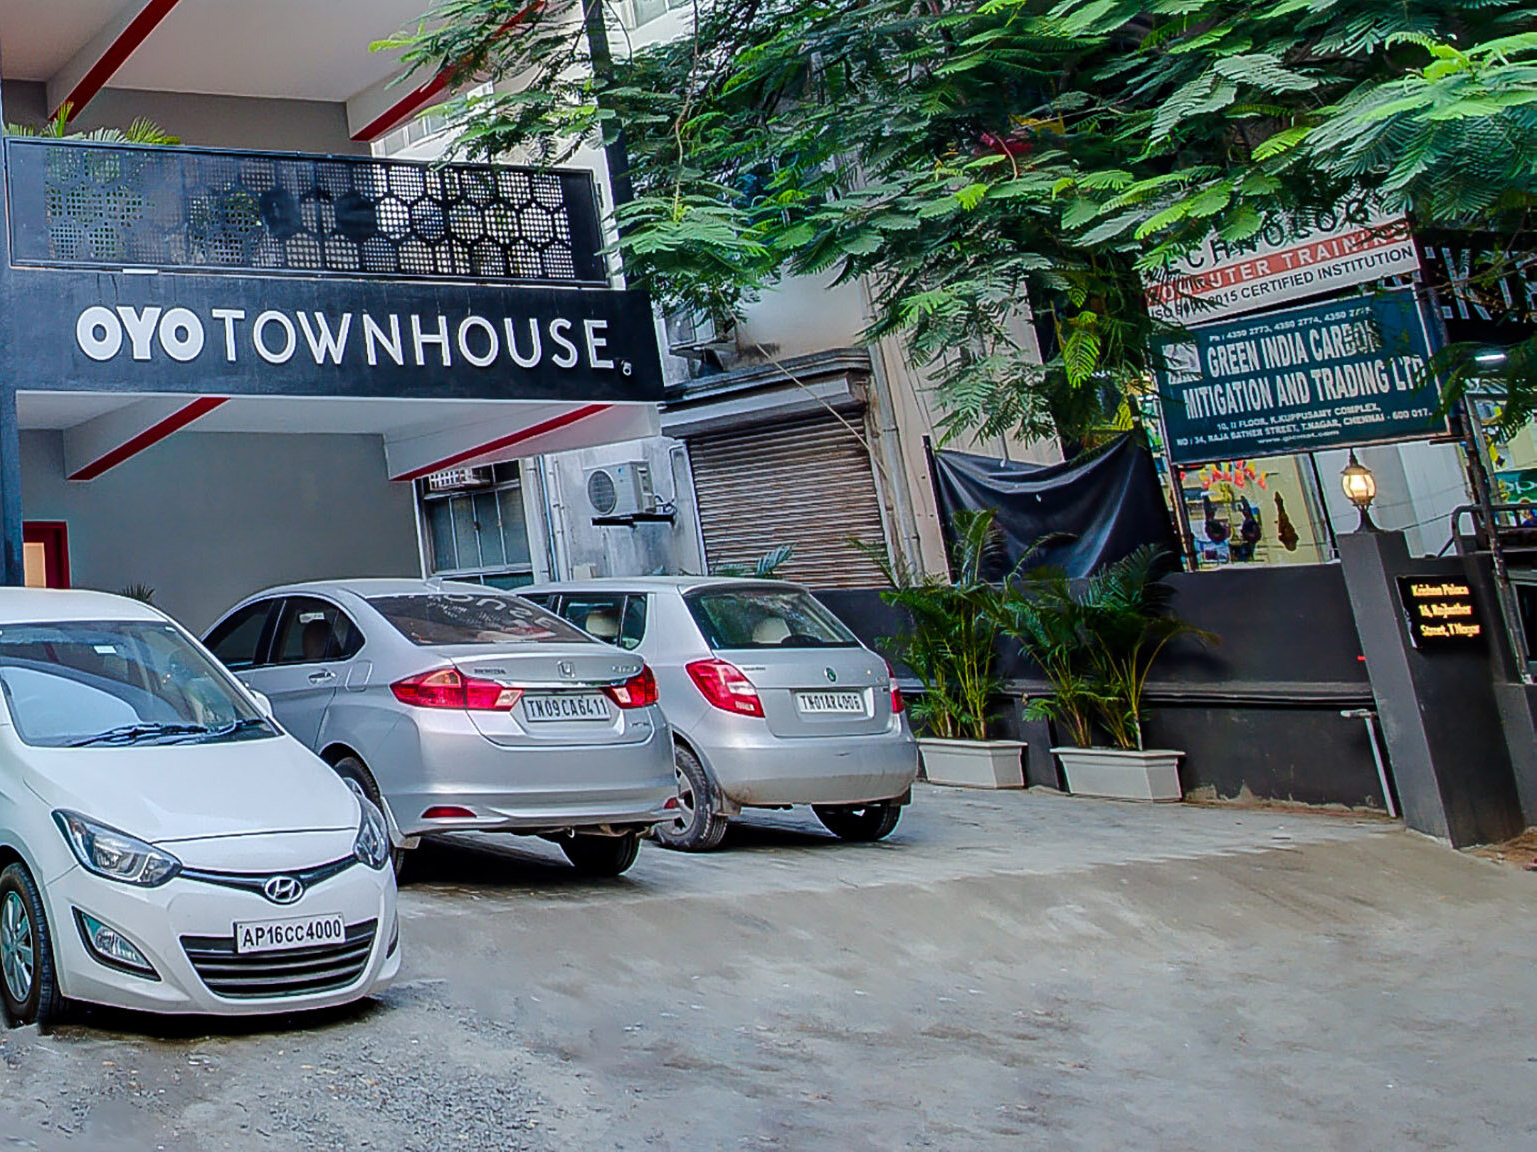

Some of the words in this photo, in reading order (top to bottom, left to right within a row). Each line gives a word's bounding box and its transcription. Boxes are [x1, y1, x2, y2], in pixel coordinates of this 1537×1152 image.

[1241, 272, 1314, 299] CERTIFIED
[1317, 245, 1414, 280] INSTITUTION
[76, 306, 205, 361] OYO
[212, 308, 614, 368] TOWNHOUSE
[1207, 336, 1261, 378] GREEN
[1261, 327, 1309, 369] INDIA
[1183, 376, 1274, 420] MITIGATION
[1276, 371, 1311, 408] AND
[1310, 359, 1390, 401] TRADING
[242, 919, 342, 948] AP16CC4000
